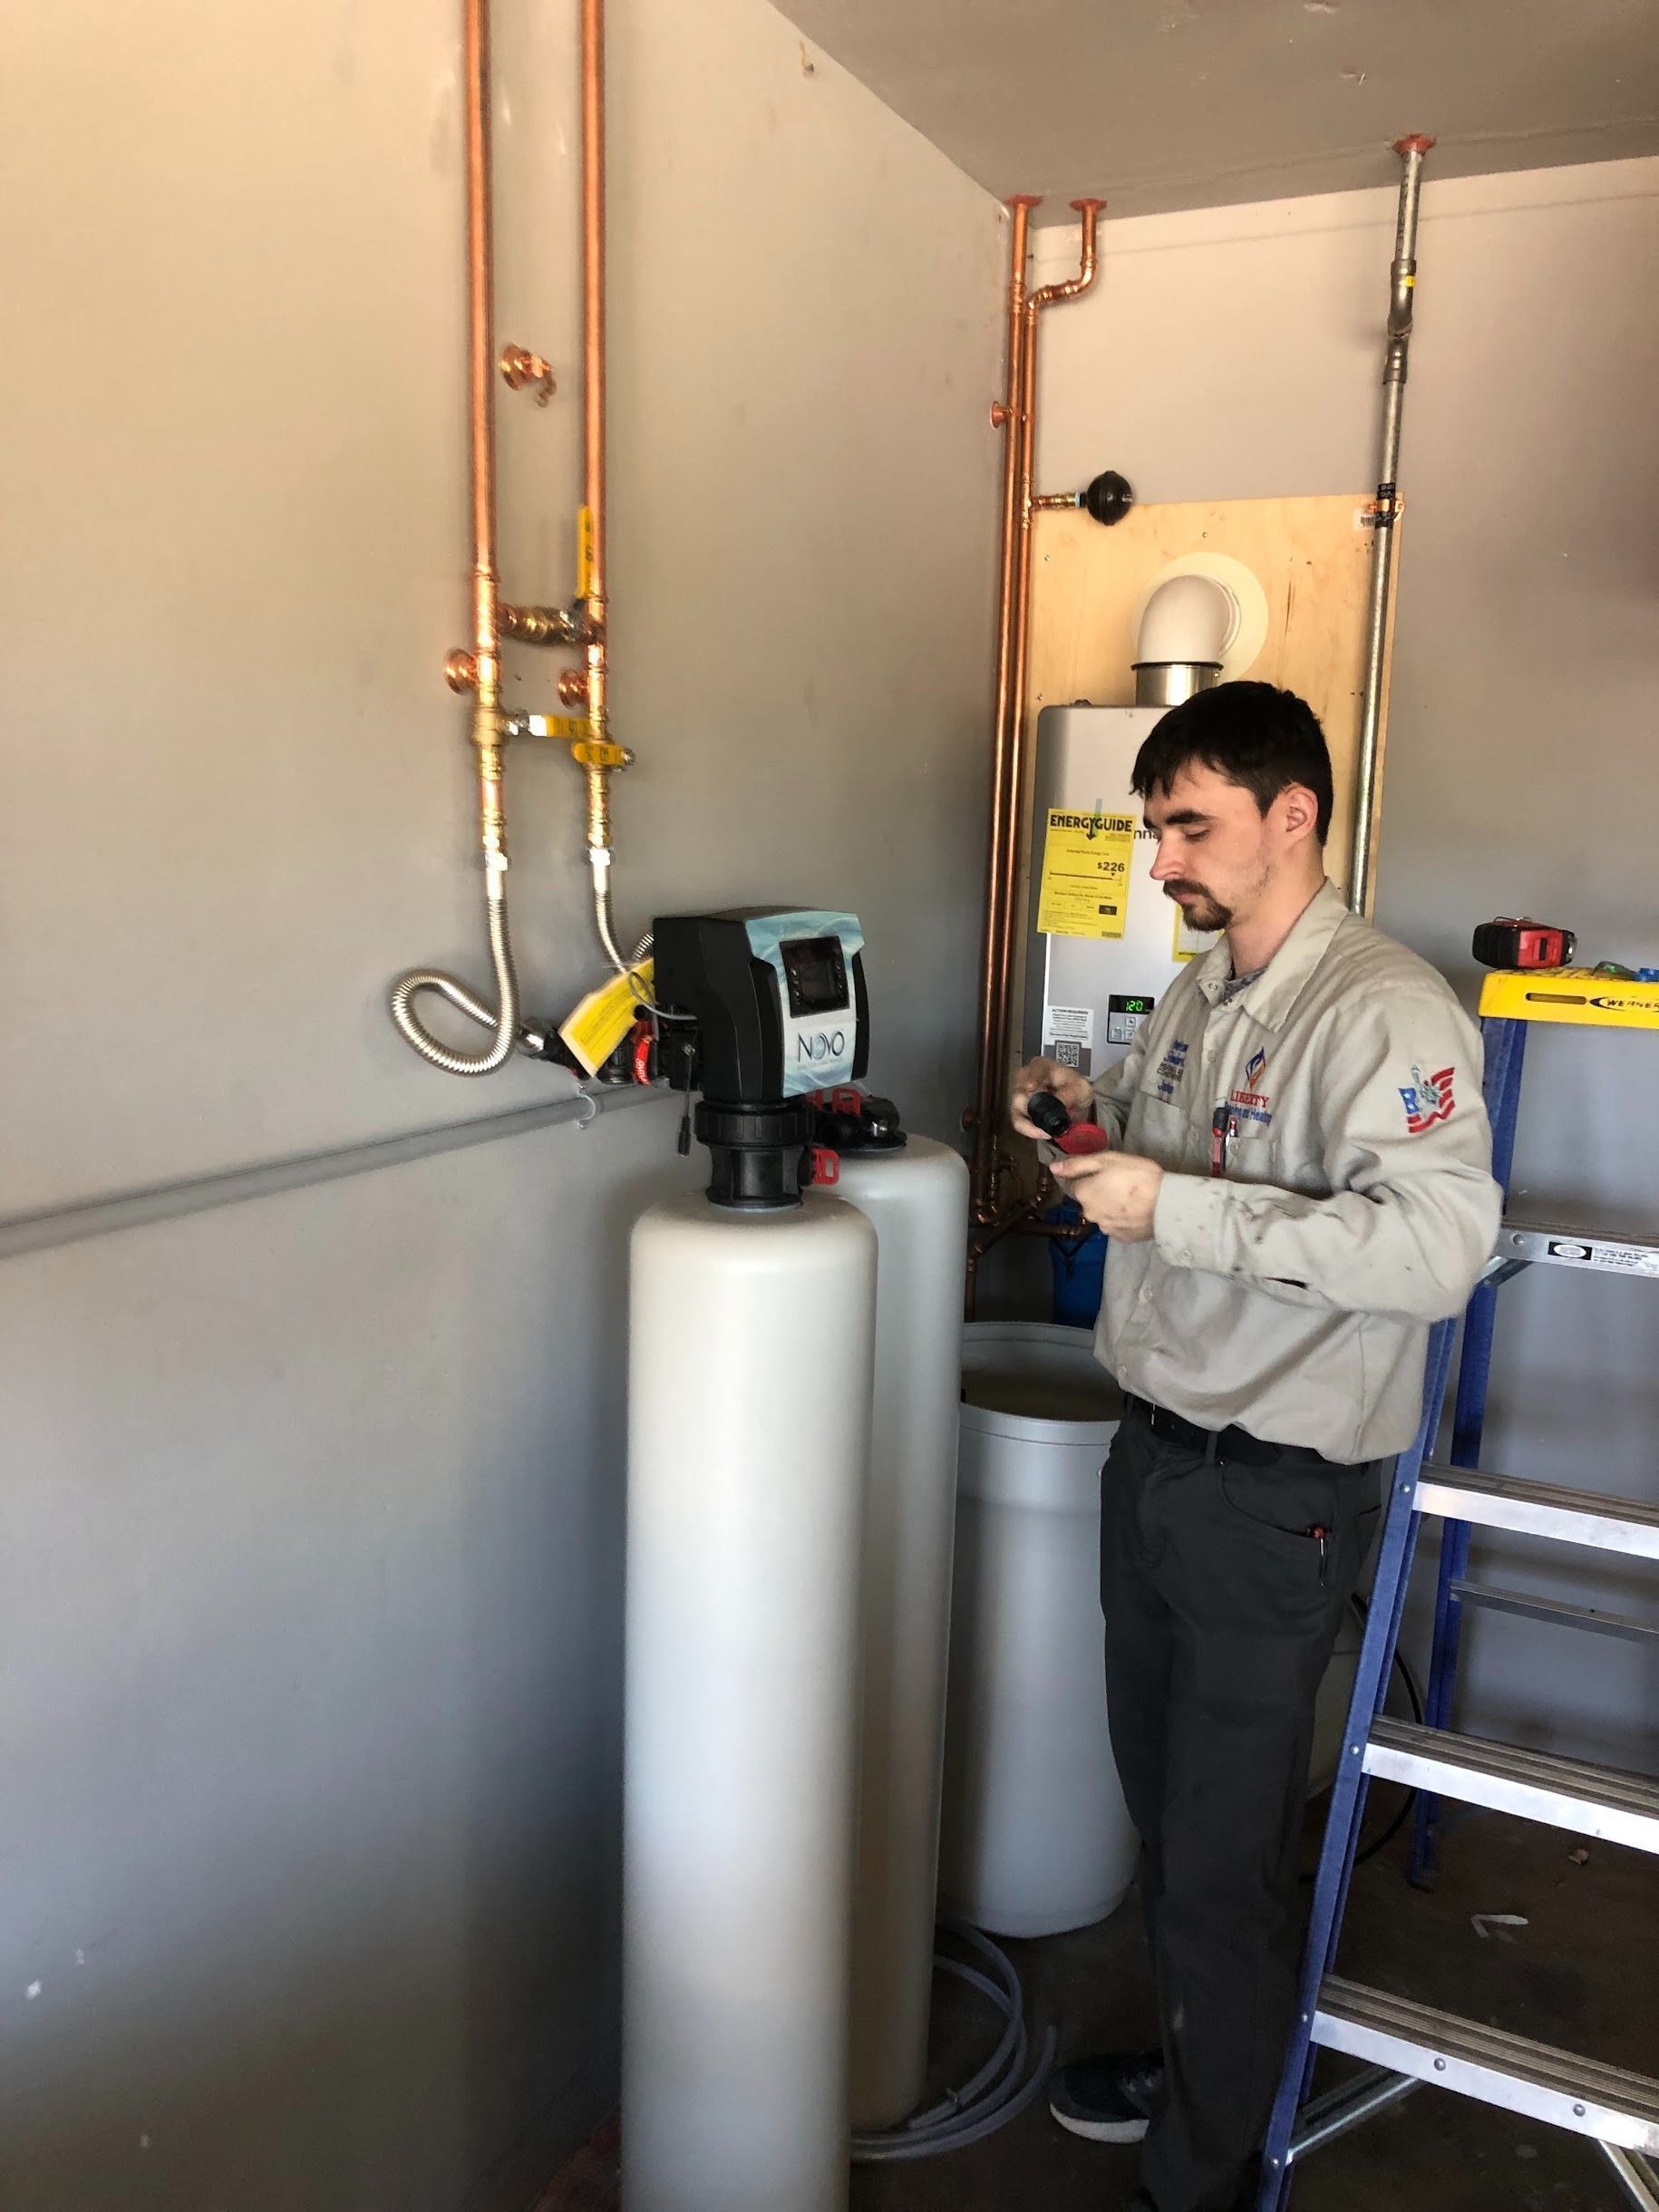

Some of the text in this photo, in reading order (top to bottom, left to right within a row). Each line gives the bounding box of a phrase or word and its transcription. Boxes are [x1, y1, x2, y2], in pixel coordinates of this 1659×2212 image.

[1050, 815, 1132, 836] ENERGYGUIDE
[1097, 861, 1125, 872] $226
[1125, 1000, 1144, 1012] 120
[797, 1031, 845, 1062] NOVO
[1230, 1090, 1269, 1108] LIBERTY
